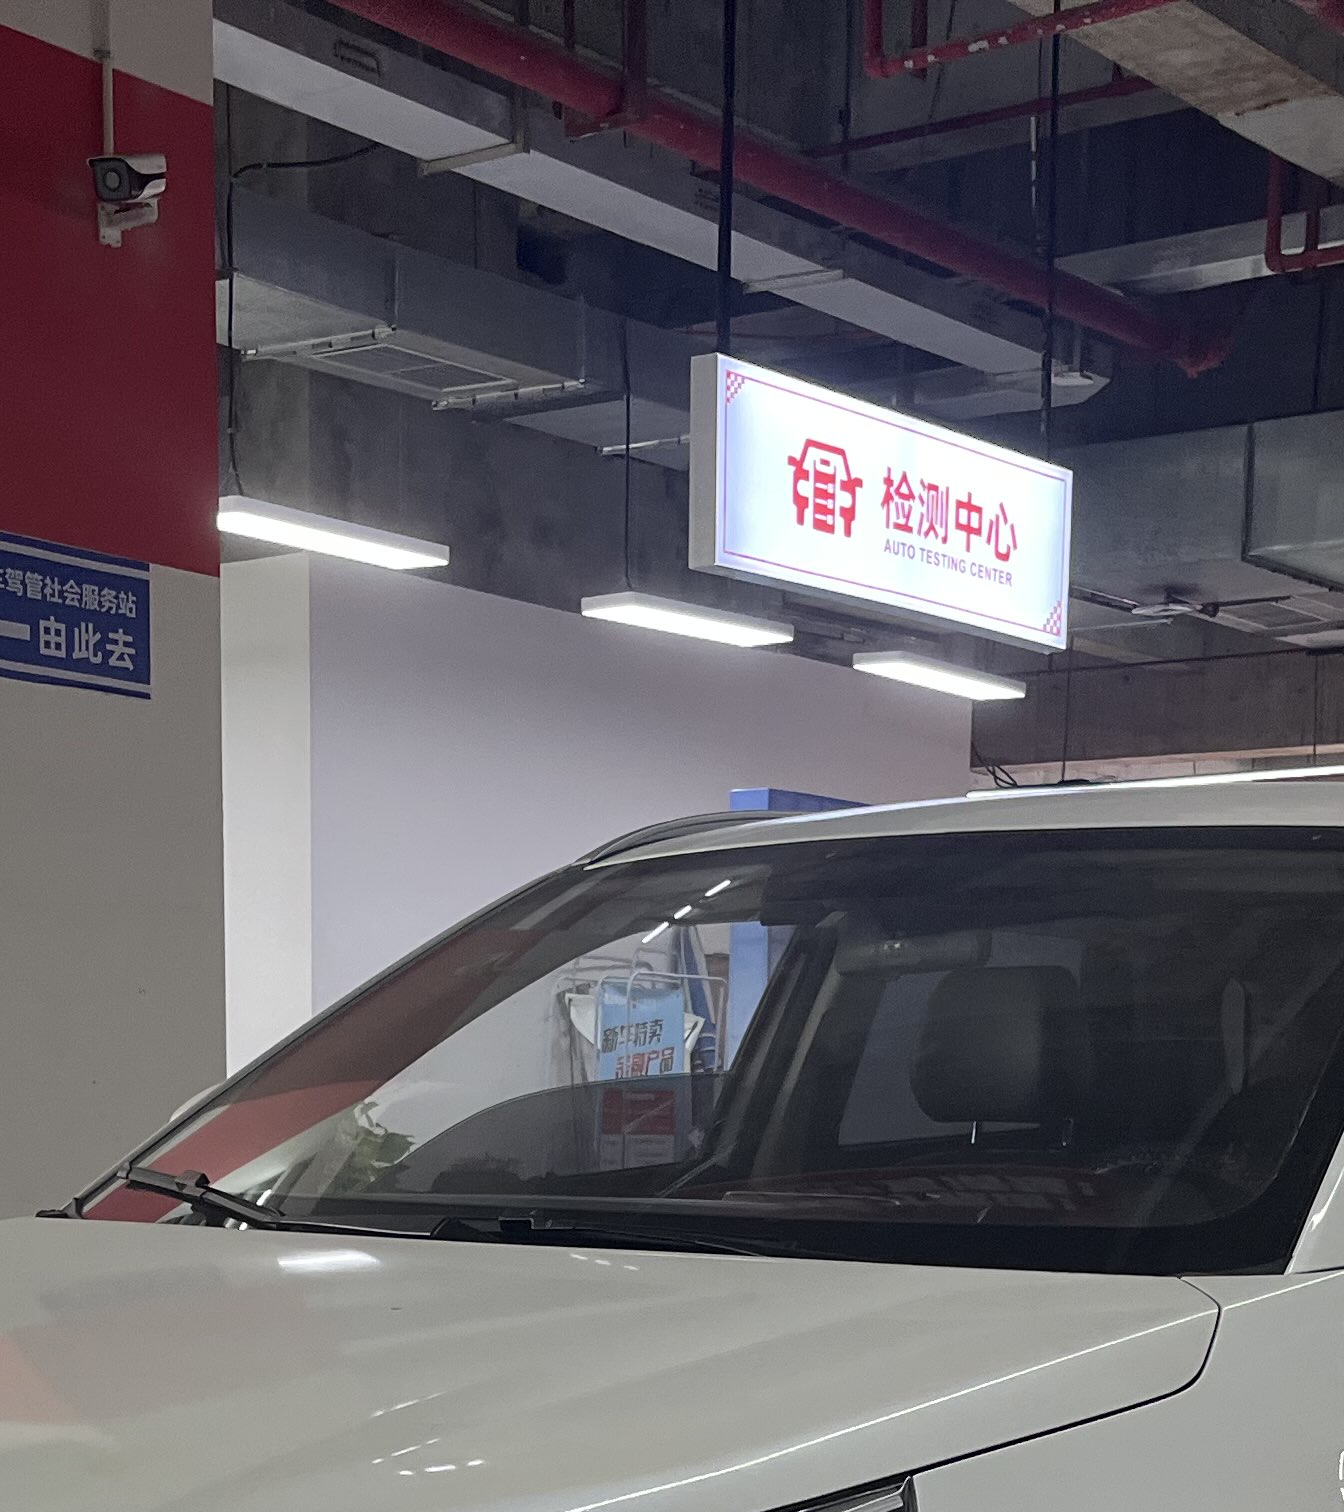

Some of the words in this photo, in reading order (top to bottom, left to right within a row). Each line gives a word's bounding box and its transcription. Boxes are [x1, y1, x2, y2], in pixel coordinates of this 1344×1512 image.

[880, 466, 1018, 563] 检测中心
[883, 538, 916, 560] AUTO
[919, 547, 967, 574] TESTING
[969, 563, 1013, 588] CENTER
[38, 615, 136, 672] 由此去
